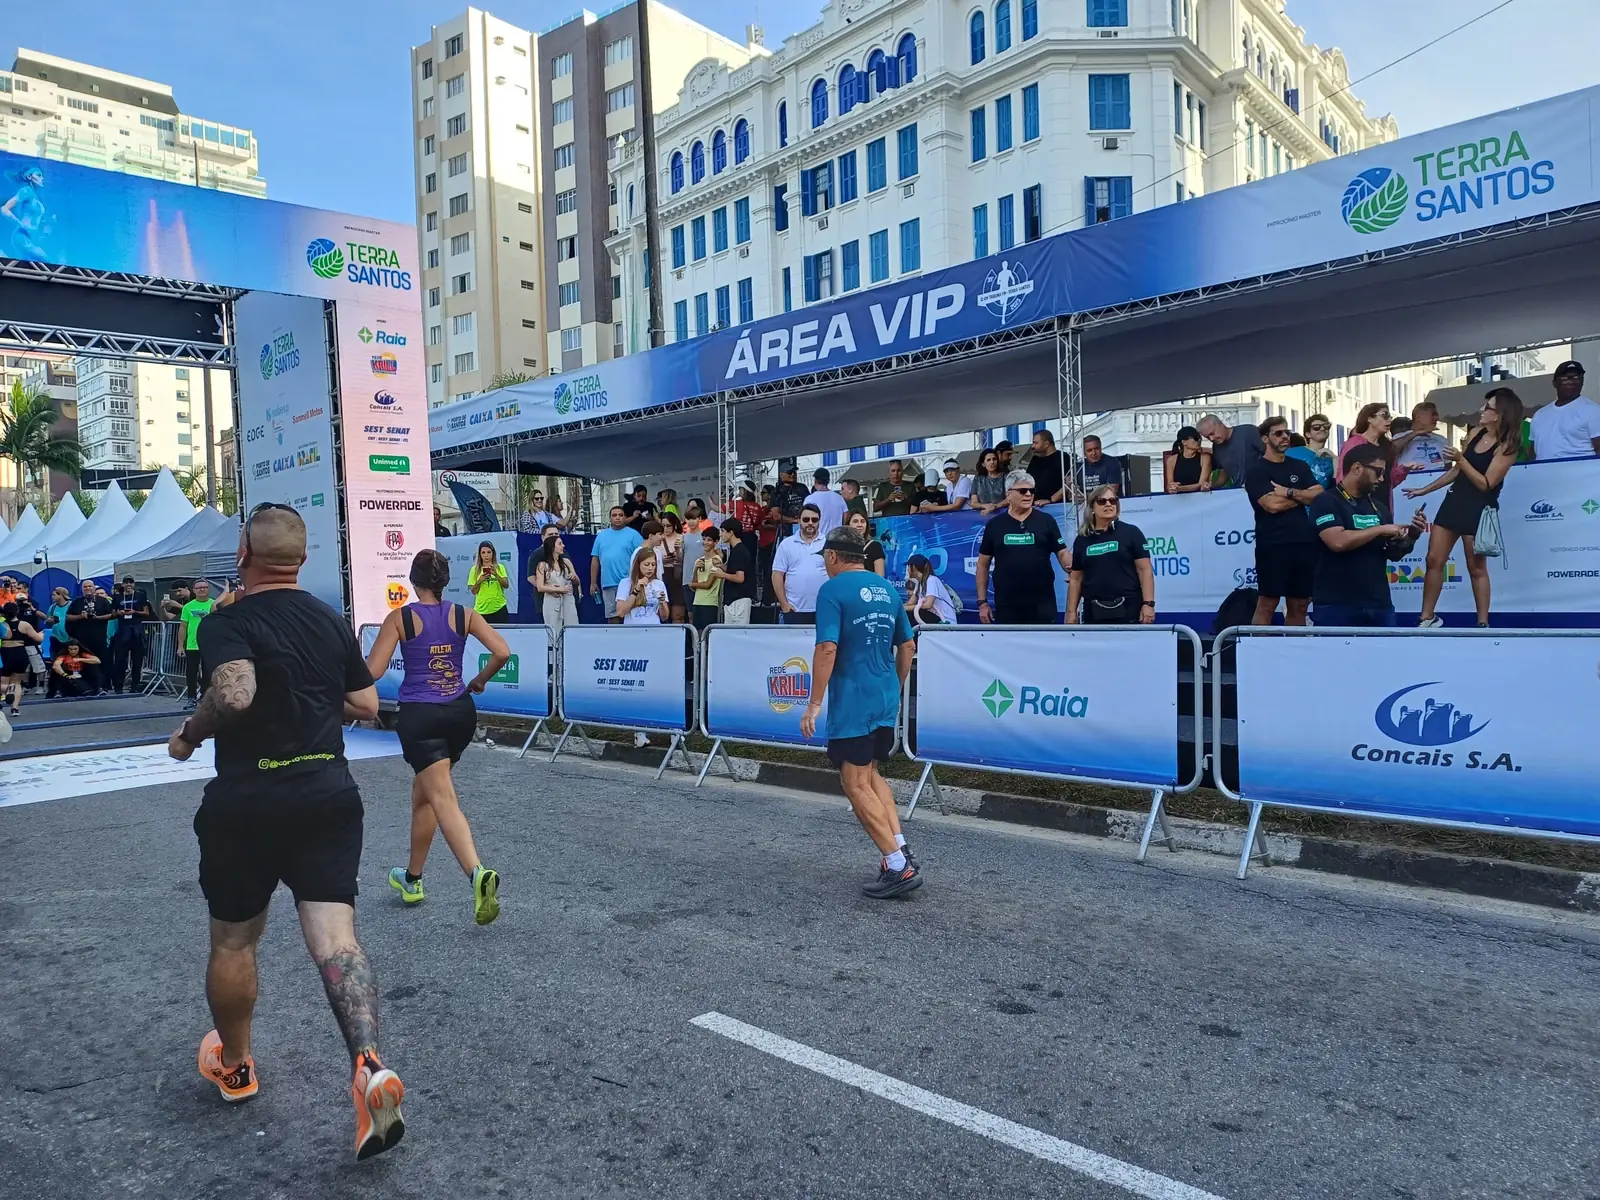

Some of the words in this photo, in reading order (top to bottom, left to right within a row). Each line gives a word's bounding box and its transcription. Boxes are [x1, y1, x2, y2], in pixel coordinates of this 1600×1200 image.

[1413, 130, 1529, 186] TERRA
[1415, 160, 1554, 222] SANTOS
[346, 242, 400, 269] TERRA
[347, 263, 412, 290] SANTOS
[376, 330, 407, 346] Raia
[725, 312, 857, 380] ÁREA
[868, 283, 966, 346] VIP
[273, 331, 295, 357] TERRA
[274, 348, 300, 376] SANTOS
[572, 374, 601, 394] TERRA
[573, 390, 608, 412] SANTOS
[469, 410, 493, 425] CAIXA
[363, 425, 384, 433] SEST
[386, 426, 411, 434] SENAT
[272, 454, 295, 473] CAIXA
[373, 458, 398, 466] Unimed
[442, 474, 454, 482] 50
[1146, 536, 1179, 556] RRA
[1214, 529, 1257, 546] EDG
[1152, 556, 1190, 577] NTOS
[1386, 563, 1463, 584] BRAIL
[869, 586, 888, 596] TERRA
[430, 645, 452, 654] ATLETA
[593, 658, 617, 671] SEST
[618, 659, 649, 672] SENAT
[769, 666, 787, 674] REDE
[608, 678, 620, 686] SEST
[769, 673, 809, 697] KRILL
[1018, 686, 1089, 718] Raia
[1351, 743, 1453, 767] Concais
[1465, 751, 1522, 772] S.A.
